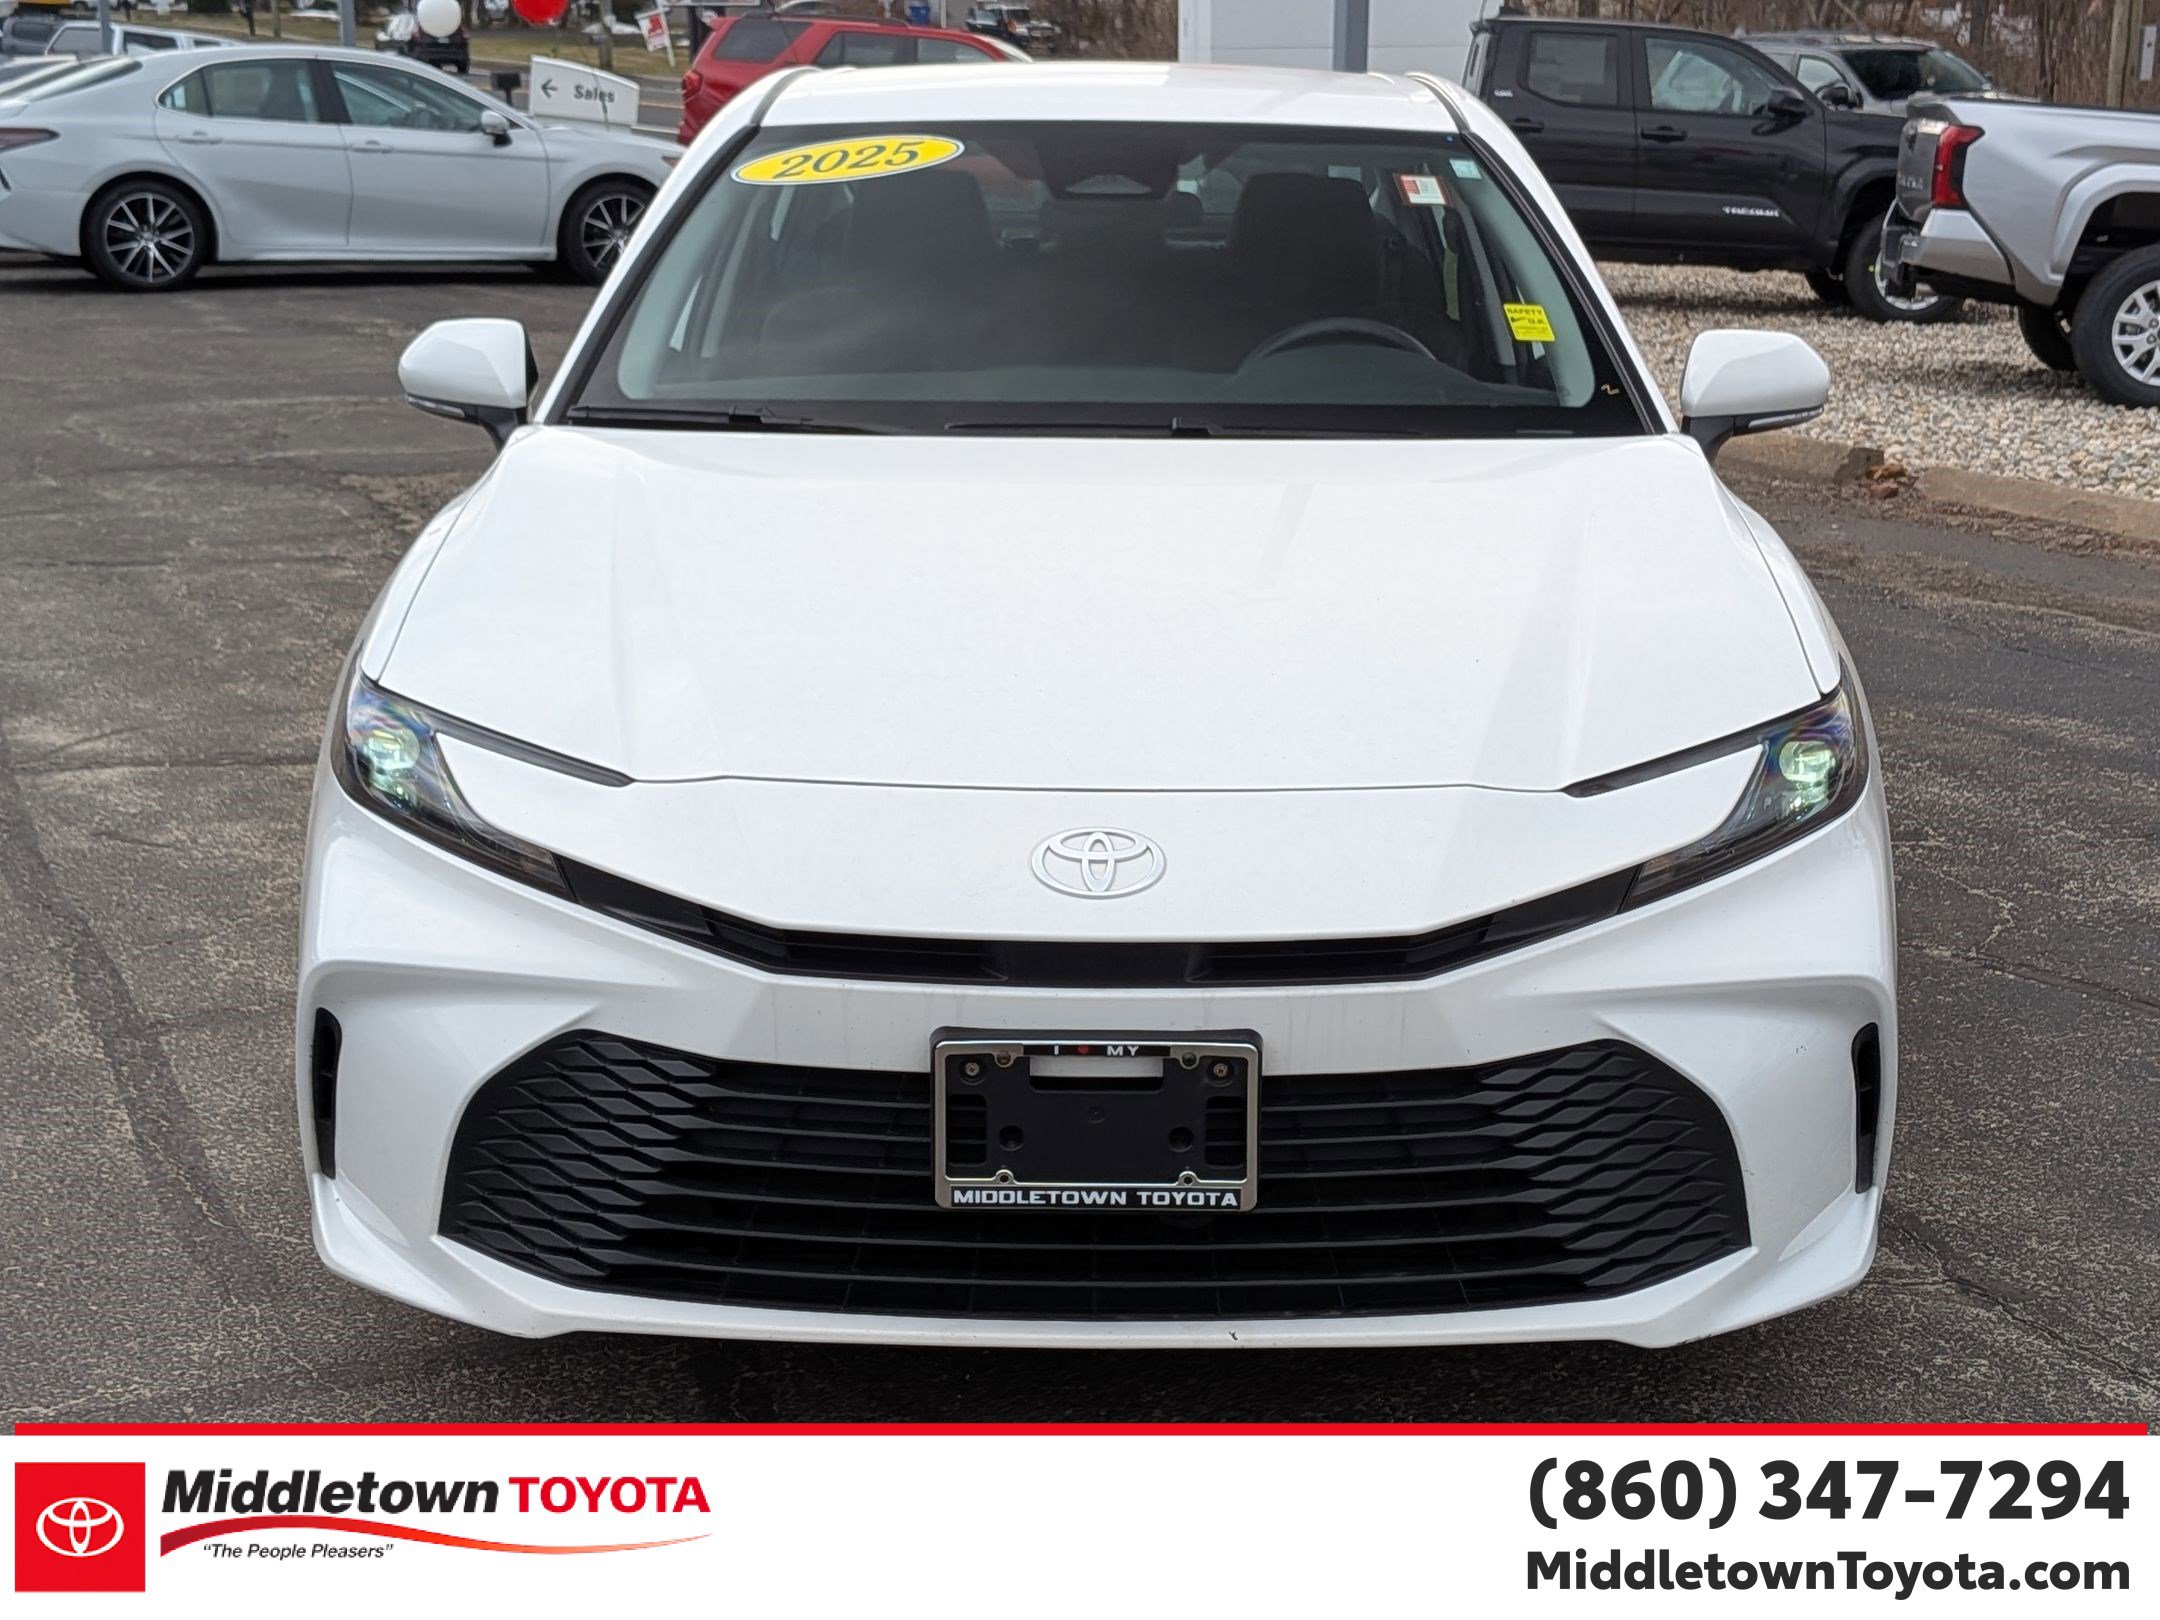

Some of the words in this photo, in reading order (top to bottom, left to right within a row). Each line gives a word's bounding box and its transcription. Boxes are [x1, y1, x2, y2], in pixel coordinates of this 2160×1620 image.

[574, 84, 615, 103] Sales
[772, 141, 924, 180] 2025
[1054, 1045, 1059, 1056] I
[1106, 1045, 1139, 1057] MY
[953, 1190, 1126, 1206] MIDDLETOWN
[1137, 1191, 1239, 1207] TOYOTA
